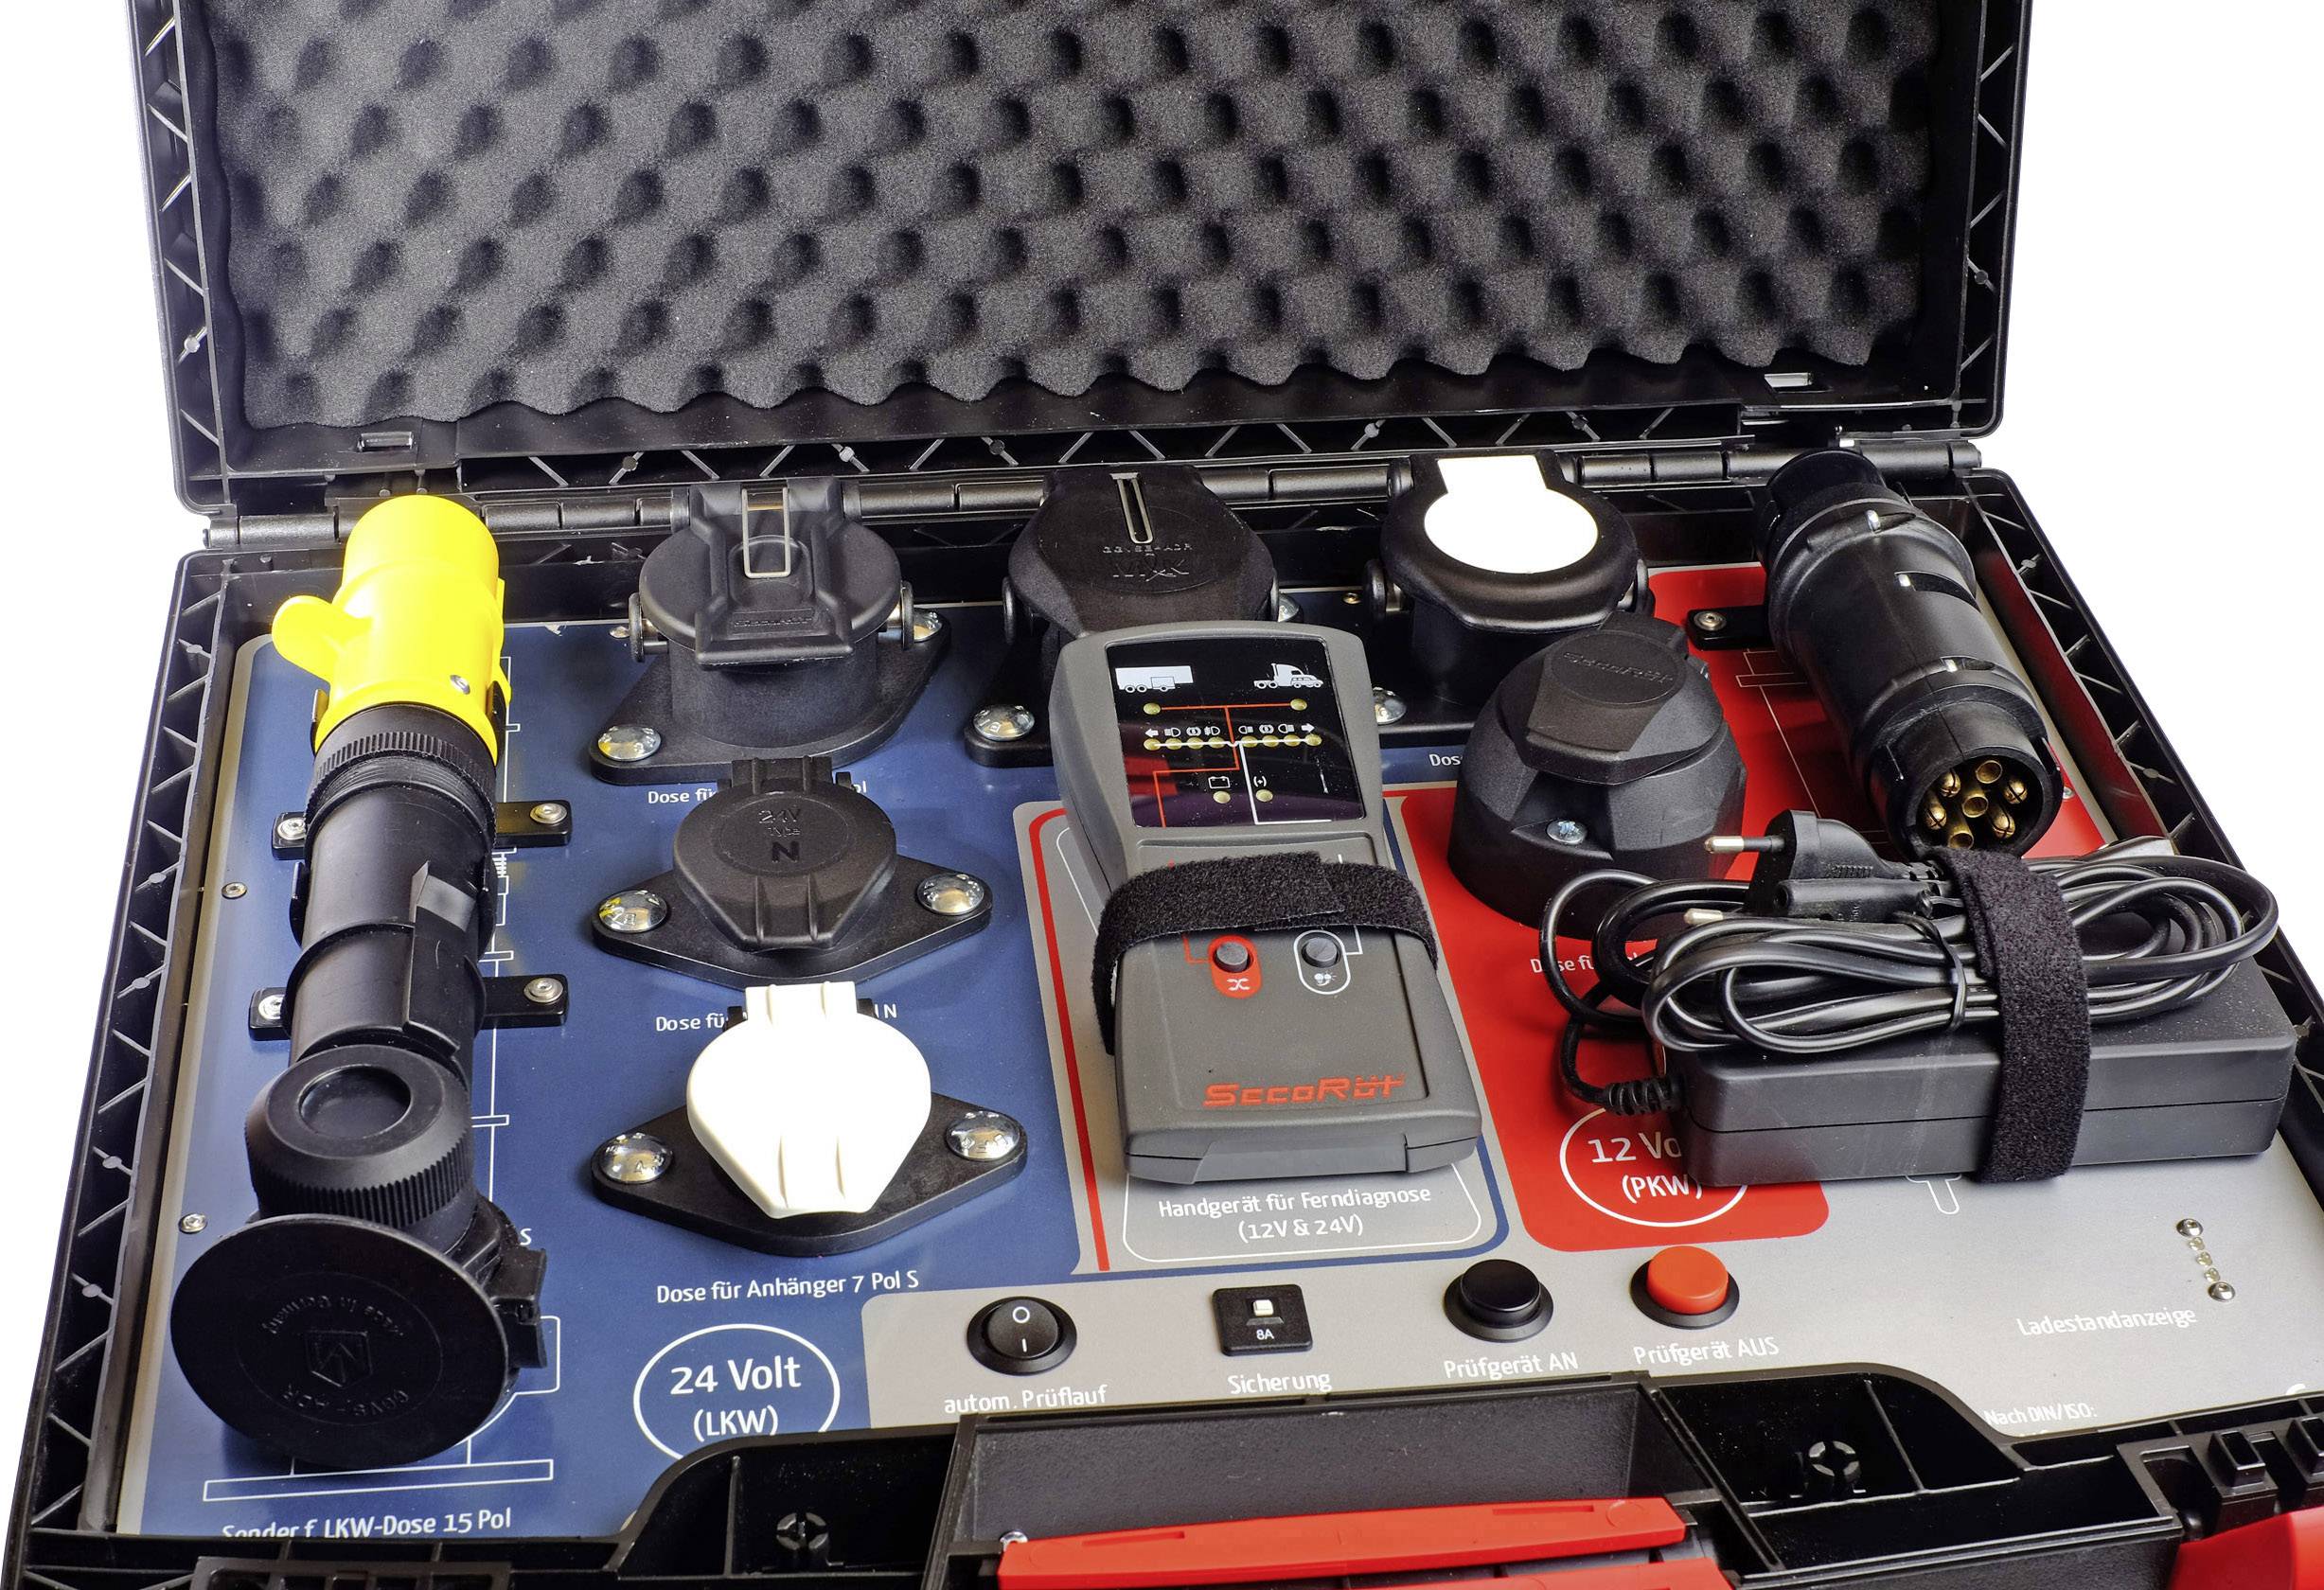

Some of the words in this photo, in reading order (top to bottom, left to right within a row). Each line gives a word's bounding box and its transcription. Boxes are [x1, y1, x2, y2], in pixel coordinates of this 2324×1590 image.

[1428, 753, 1464, 767] Dos
[648, 789, 690, 804] Dose
[695, 787, 717, 802] fü
[1530, 958, 1576, 974] Dse
[655, 1016, 701, 1033] Dose
[705, 1012, 729, 1029] fü
[1588, 1136, 1637, 1164] 12
[1638, 1131, 1682, 1159] Vo
[1158, 1195, 1262, 1219] Handgerät
[1266, 1193, 1296, 1211] für
[1302, 1187, 1432, 1210] Ferndiagnose
[1238, 1219, 1288, 1244] (12V
[1293, 1217, 1311, 1237] &
[1315, 1212, 1364, 1237] 24V)
[657, 1285, 706, 1303] Dose
[710, 1281, 742, 1300] für
[746, 1277, 846, 1298] Anhänger
[852, 1275, 864, 1293] 7
[872, 1270, 900, 1290] Pol
[906, 1269, 919, 1289] S
[1256, 1329, 1274, 1340] 8A
[2016, 1307, 2198, 1336] Ladestandanzeige
[1633, 1341, 1733, 1367] Prüfgerät
[1738, 1336, 1780, 1357] AUS
[670, 1365, 718, 1395] 24
[727, 1354, 802, 1391] Volt
[1444, 1353, 1543, 1381] Prüfgerät
[1549, 1352, 1579, 1371] AN
[1021, 1384, 1108, 1408] Prüflauf
[1227, 1372, 1333, 1395] Sicherung
[693, 1404, 779, 1442] (LKW)
[1983, 1406, 2030, 1427] Nach
[2028, 1403, 2098, 1422] DIN/ISO:
[324, 1514, 436, 1539] LKW-Dose
[443, 1512, 474, 1533] 15
[477, 1506, 512, 1529] Pol
